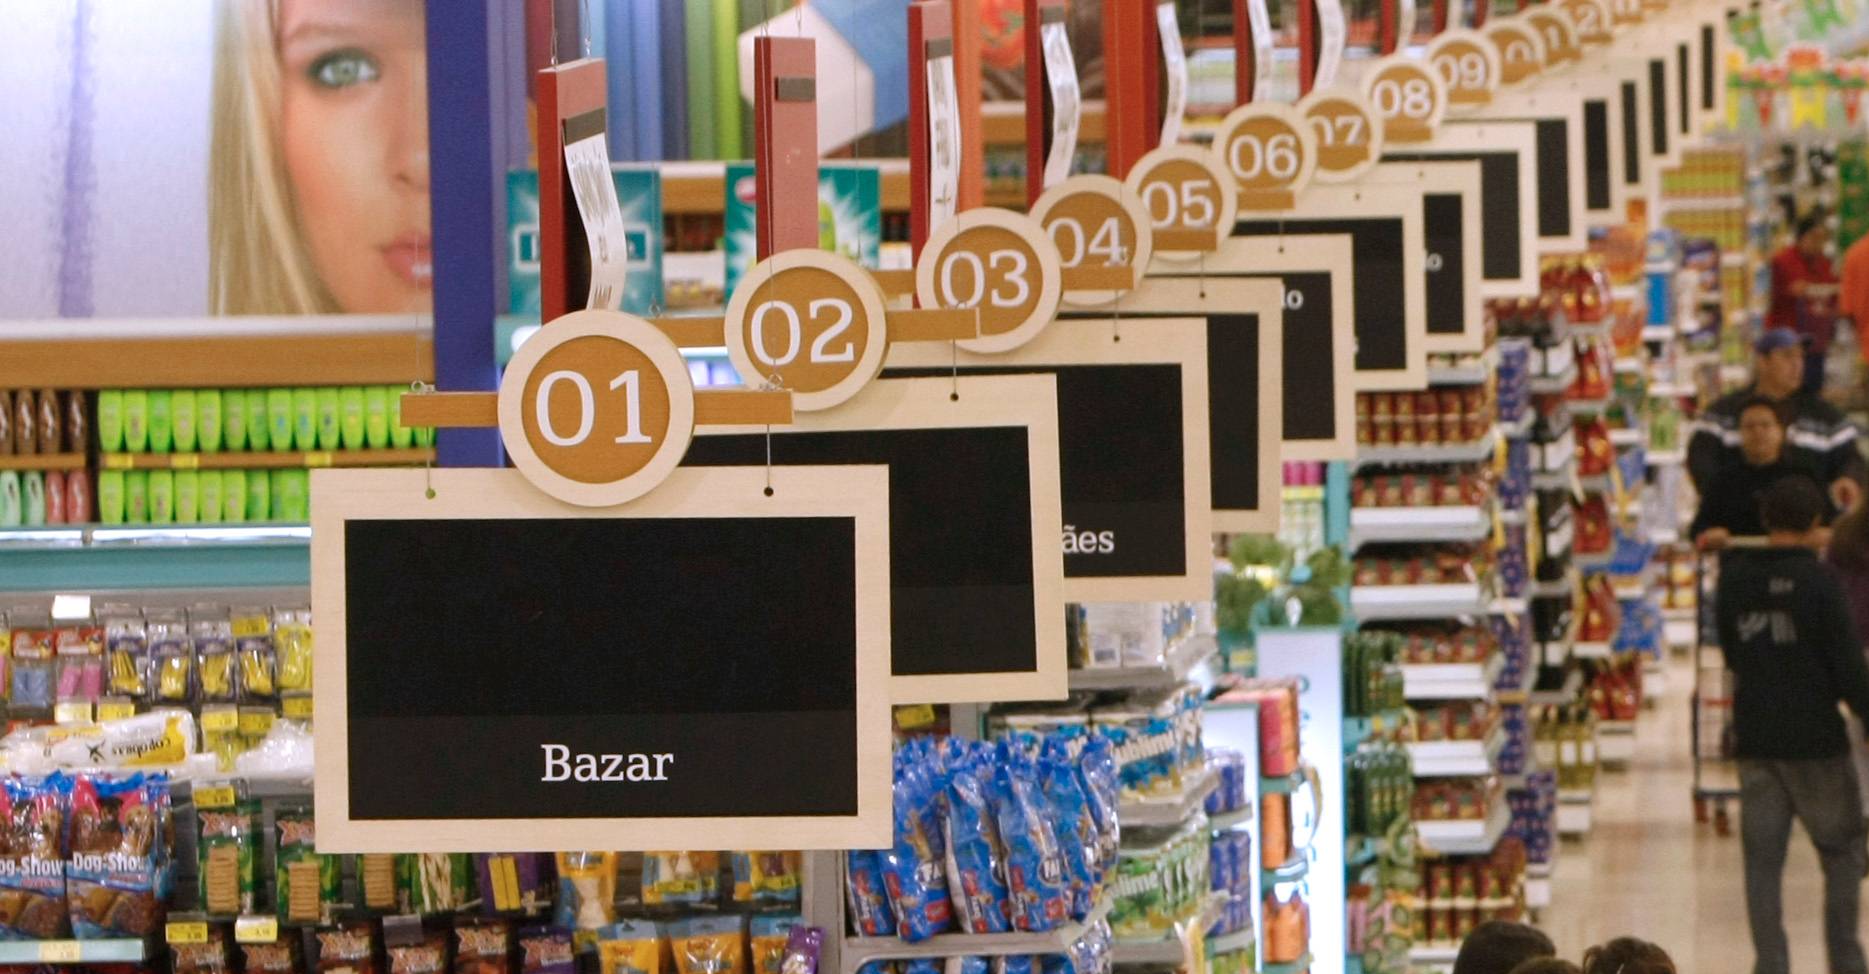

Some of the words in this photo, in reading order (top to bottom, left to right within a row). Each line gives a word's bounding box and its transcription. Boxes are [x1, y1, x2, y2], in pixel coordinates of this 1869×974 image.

[1435, 53, 1487, 90] 09
[1372, 77, 1431, 119] 08
[1311, 114, 1363, 148] 07
[1229, 134, 1299, 180] 06
[1142, 180, 1215, 230] 05
[1048, 216, 1125, 267] 04
[940, 249, 1029, 309] 03
[750, 298, 854, 366] 02
[534, 368, 653, 446] 01
[541, 742, 674, 782] Bazar
